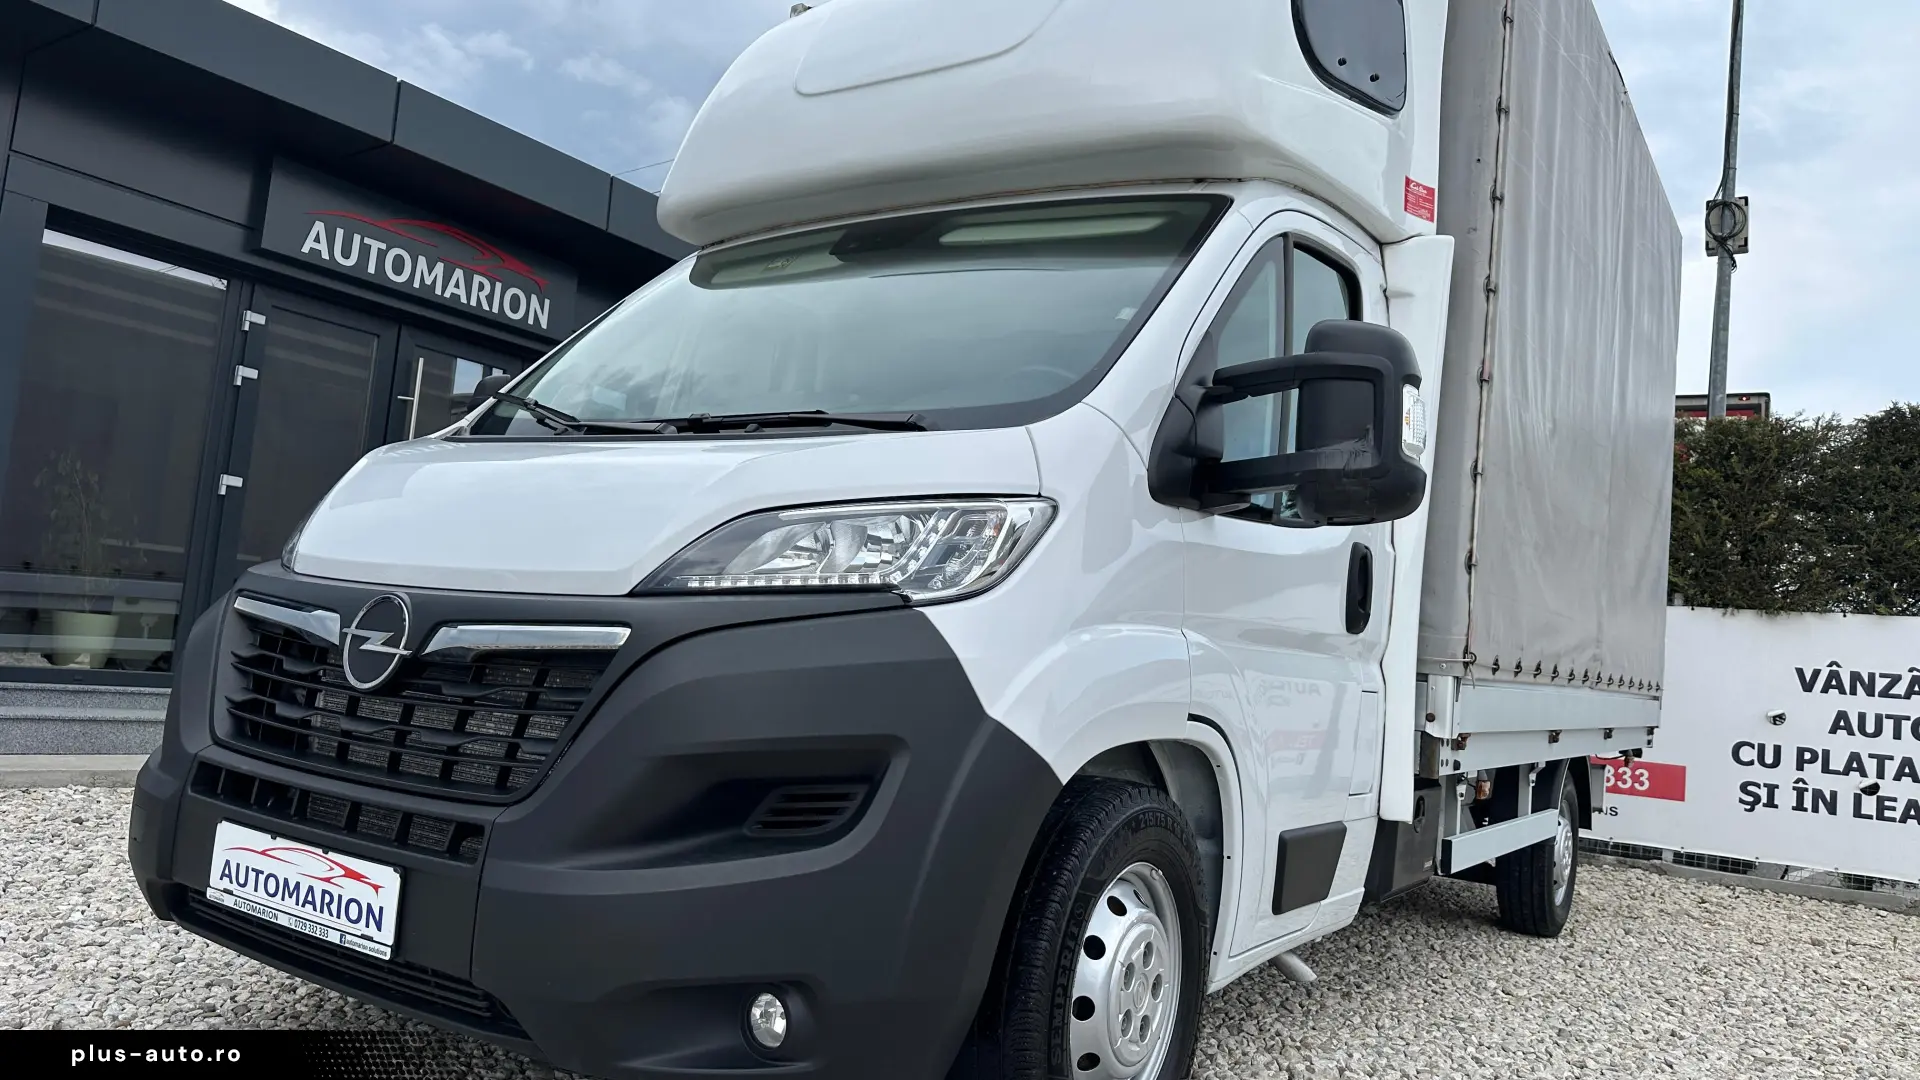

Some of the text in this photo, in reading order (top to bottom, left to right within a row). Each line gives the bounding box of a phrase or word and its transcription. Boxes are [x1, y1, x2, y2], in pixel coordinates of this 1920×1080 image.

[300, 219, 551, 330] AUTOMARION
[1731, 740, 1920, 784] CU PLATA
[1791, 777, 1838, 816] ÎN
[1852, 792, 1920, 826] LEA
[219, 858, 384, 932] AUTOMARION
[233, 898, 279, 921] AUTOMARION
[293, 918, 307, 931] 0729
[308, 923, 319, 935] 332
[319, 927, 329, 939] 333
